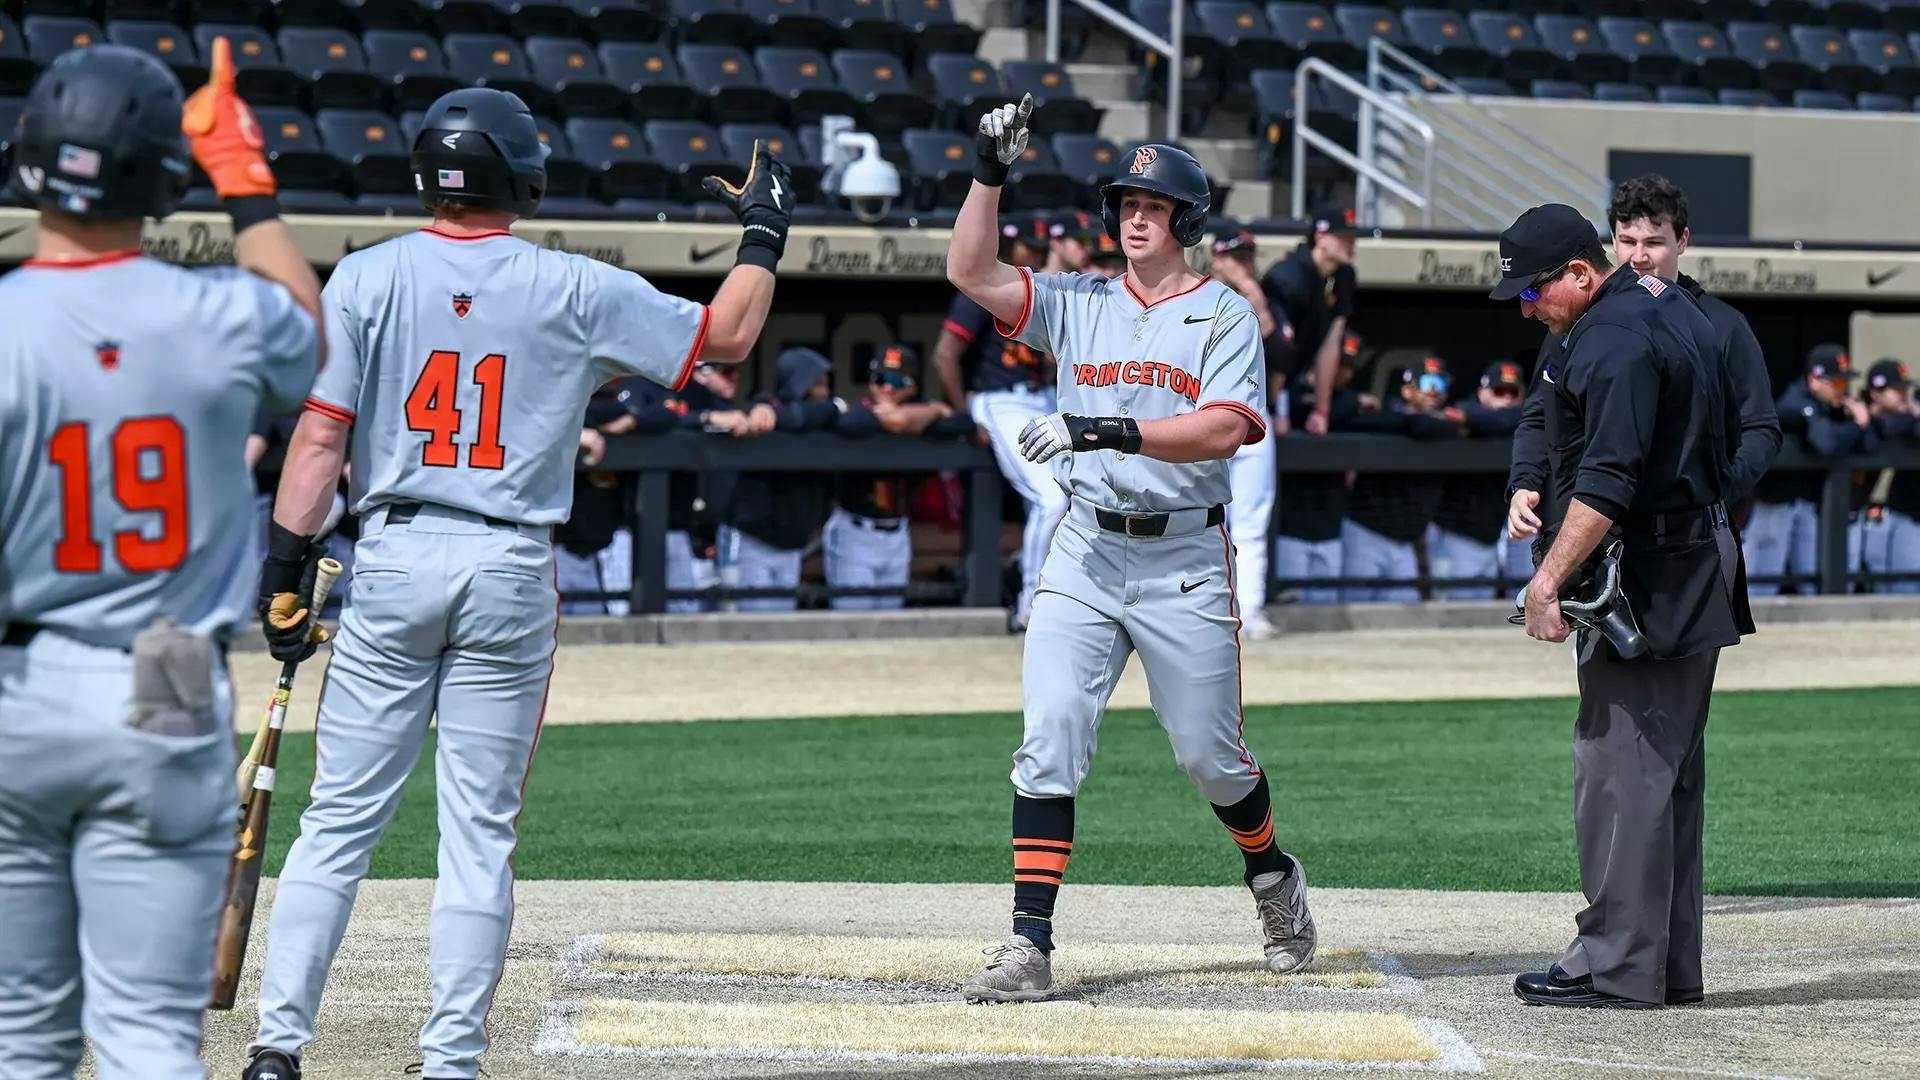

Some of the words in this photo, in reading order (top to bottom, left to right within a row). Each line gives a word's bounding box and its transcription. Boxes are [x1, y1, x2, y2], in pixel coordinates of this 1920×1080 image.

[1129, 147, 1158, 174] P
[404, 350, 506, 470] 41
[49, 415, 189, 573] 19
